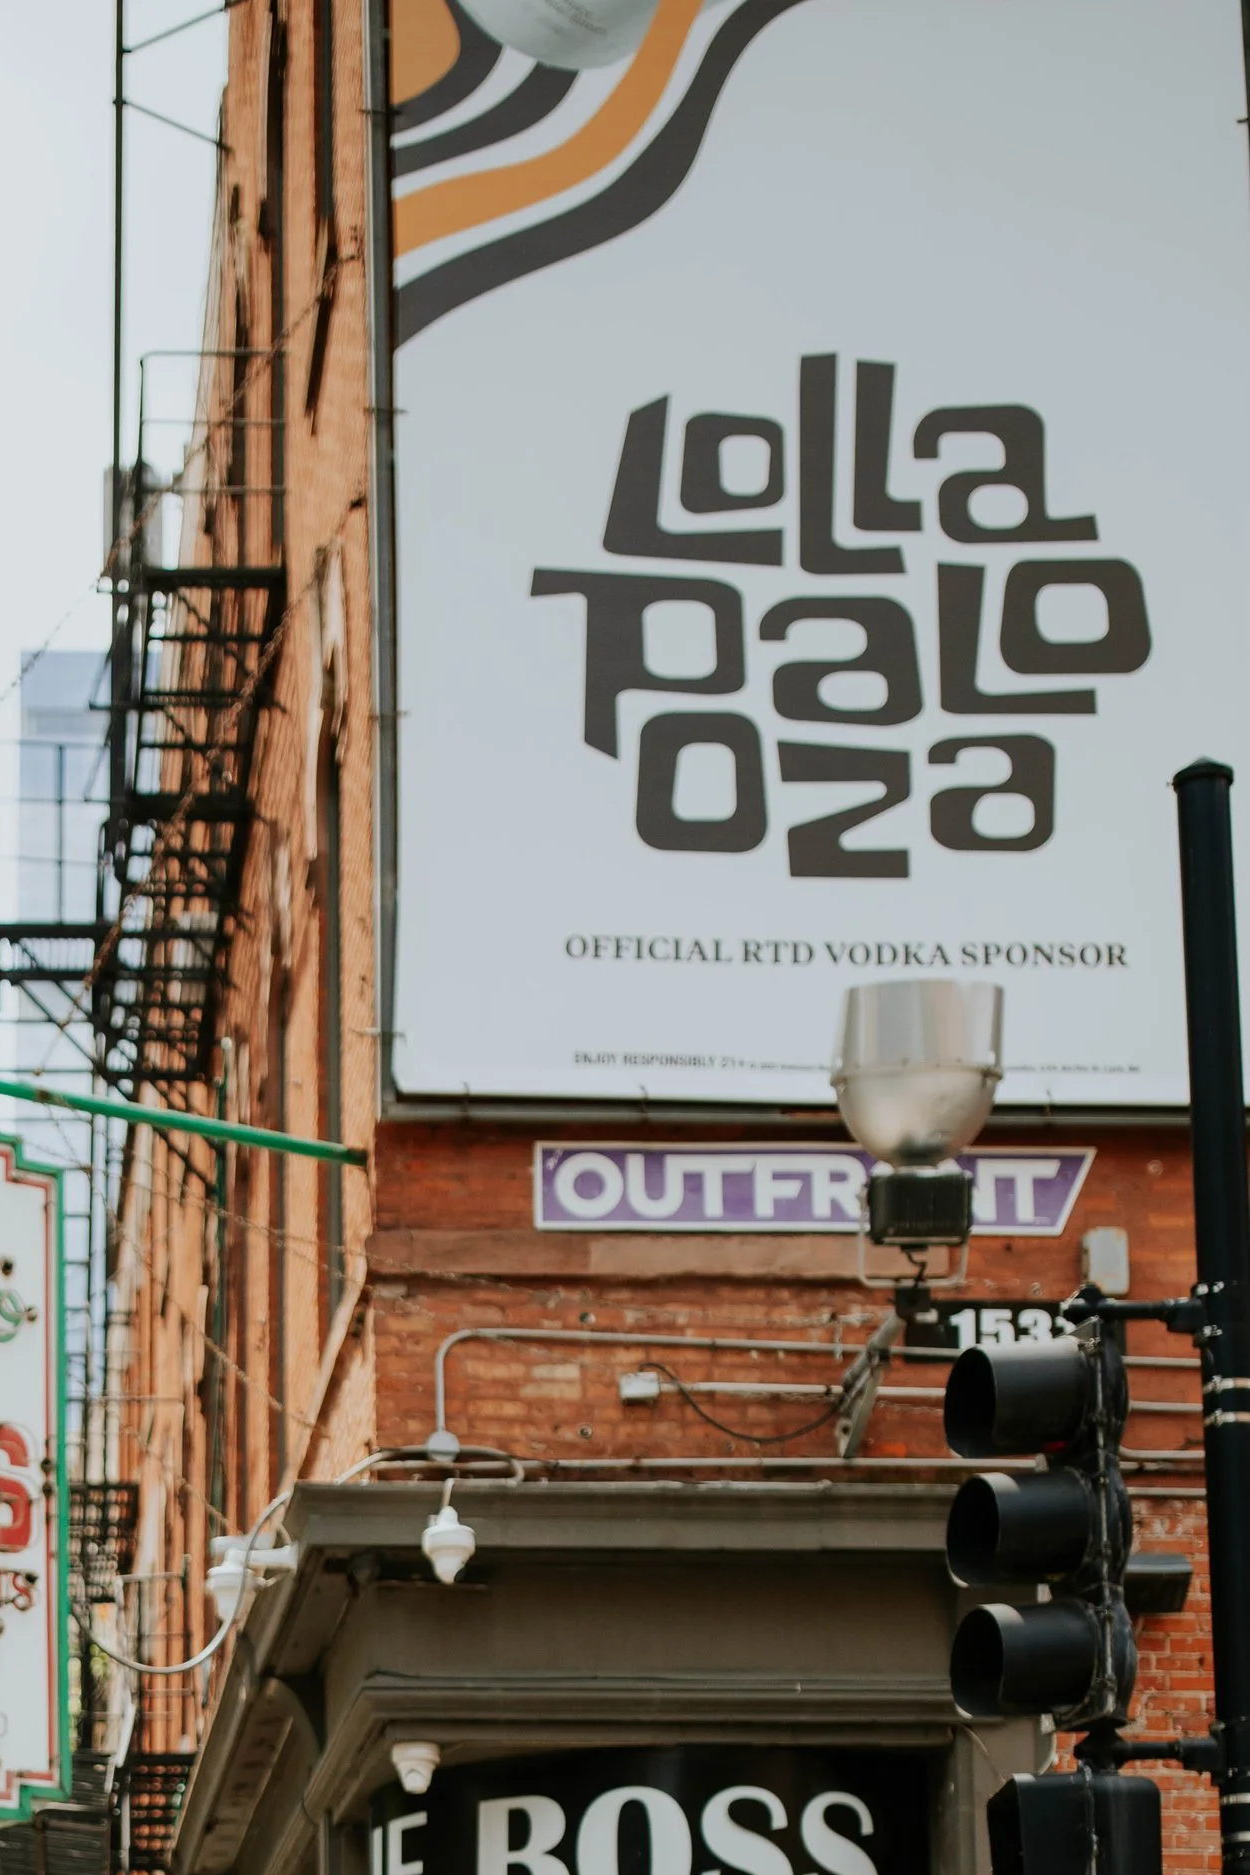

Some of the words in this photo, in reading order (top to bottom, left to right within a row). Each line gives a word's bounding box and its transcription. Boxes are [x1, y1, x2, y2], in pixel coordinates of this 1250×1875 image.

[565, 934, 732, 963] OFFICIAL
[742, 937, 815, 966] RTD
[823, 940, 951, 968] VODKA
[960, 941, 1129, 970] SPONSOR
[623, 1053, 715, 1068] RESPONSIBLY
[553, 1152, 1062, 1222] OUTFRNT
[950, 1308, 1078, 1349] 153
